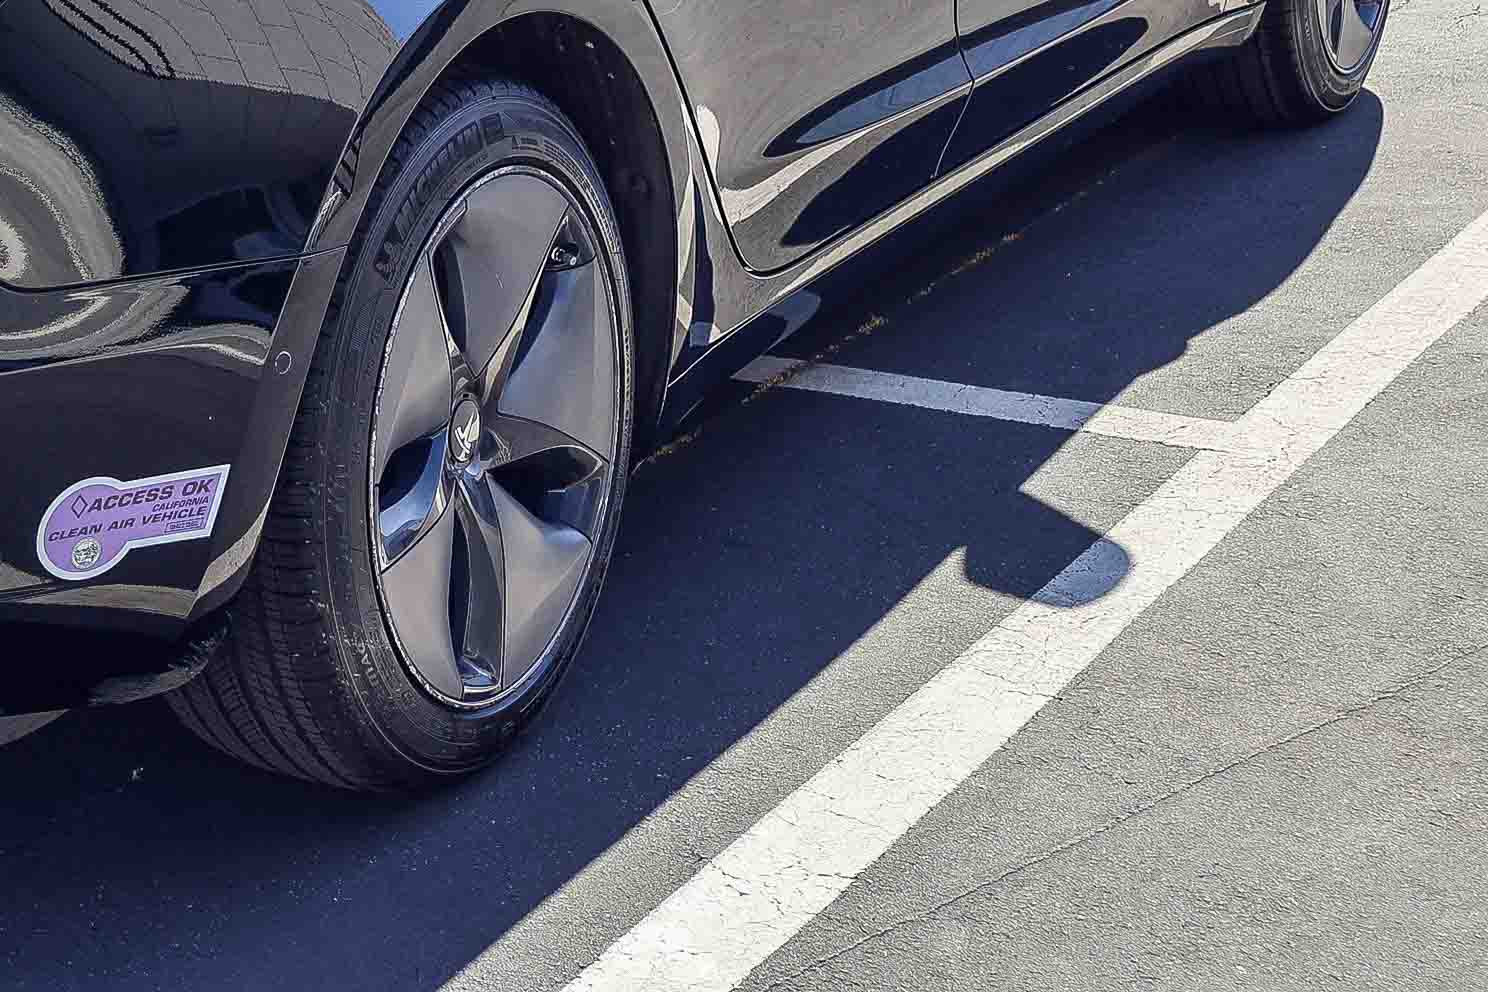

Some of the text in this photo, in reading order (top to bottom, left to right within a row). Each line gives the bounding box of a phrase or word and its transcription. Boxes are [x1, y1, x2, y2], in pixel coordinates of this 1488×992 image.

[88, 478, 214, 513] ACCESS OK
[152, 495, 209, 512] CALIFORNIA
[48, 506, 208, 542] CLEAN AIR VEHICLE
